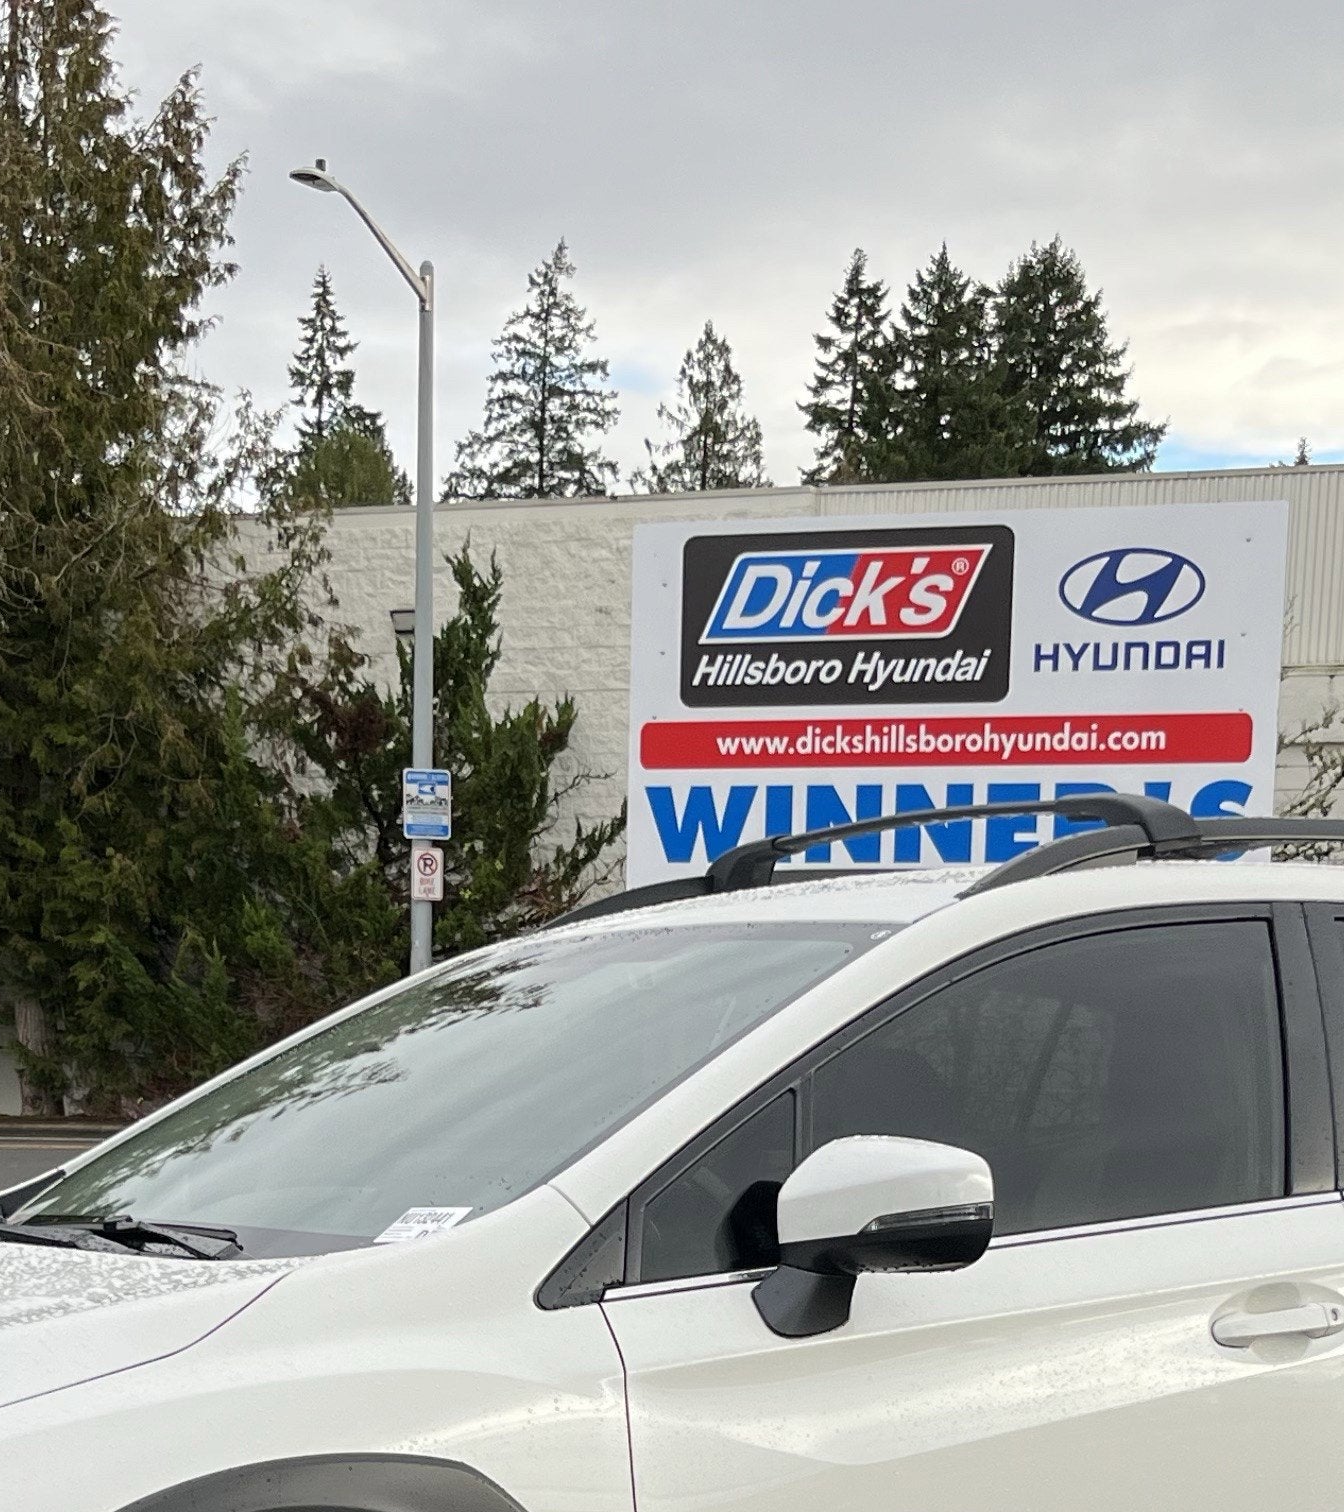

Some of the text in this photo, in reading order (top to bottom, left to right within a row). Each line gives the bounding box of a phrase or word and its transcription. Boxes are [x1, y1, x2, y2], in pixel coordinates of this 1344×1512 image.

[722, 556, 954, 630] Dick's
[692, 649, 992, 692] Hillsboro Hyundai
[1034, 639, 1225, 673] HYUNDAI
[716, 723, 1167, 761] www.dickshillsborohyundai.com
